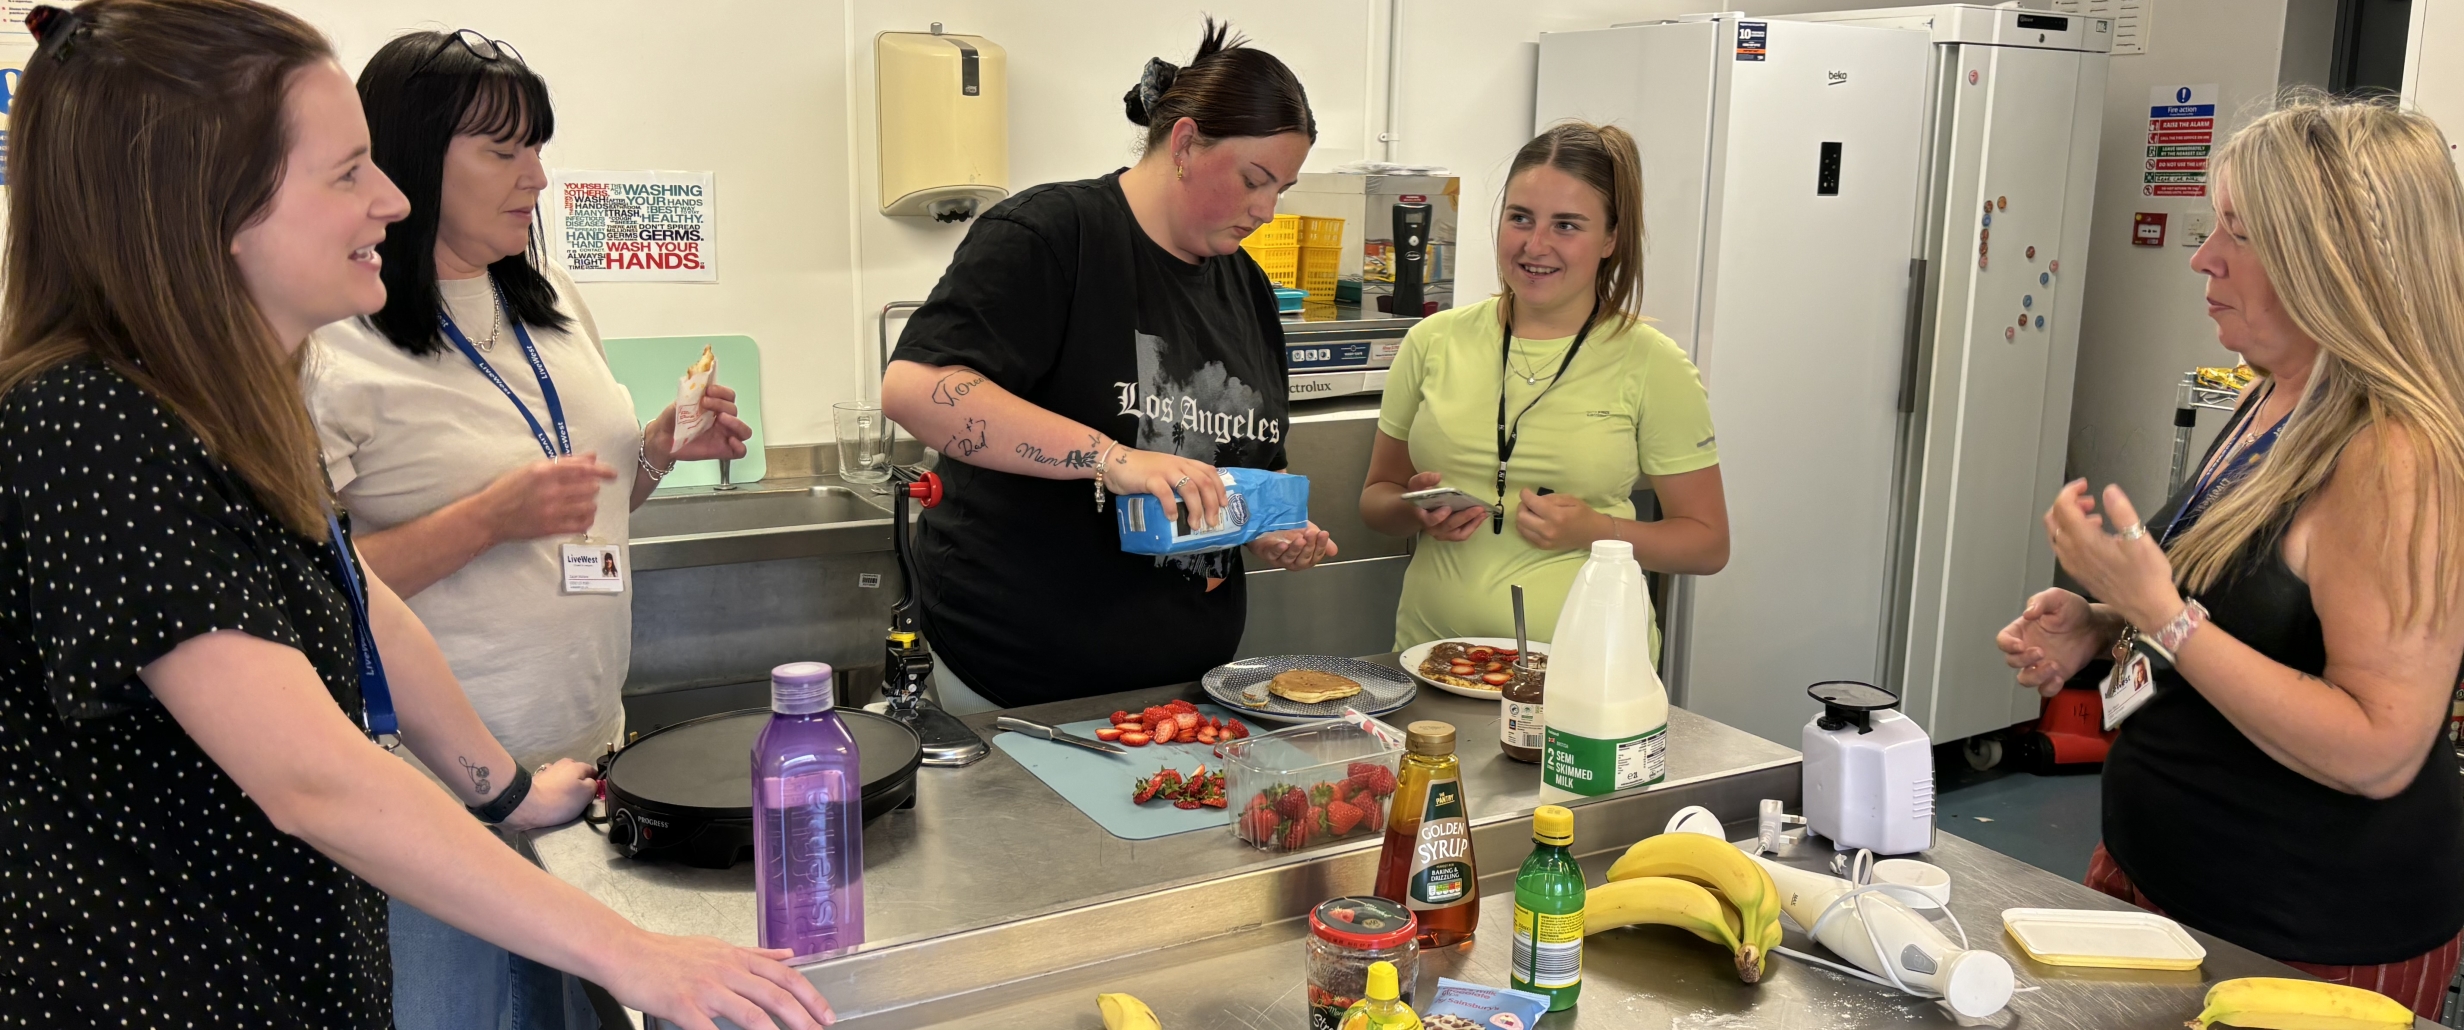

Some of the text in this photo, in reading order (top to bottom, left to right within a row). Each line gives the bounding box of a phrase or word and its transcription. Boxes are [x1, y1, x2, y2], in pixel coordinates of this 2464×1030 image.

[1739, 28, 1752, 40] 10
[1828, 70, 1847, 80] beko
[622, 184, 702, 196] WASHING
[626, 196, 666, 205] YOUR
[650, 206, 679, 214] BEST
[641, 214, 704, 223] HEALTHY.
[566, 231, 606, 240] HAND
[639, 230, 704, 241] GERMS.
[606, 242, 698, 252] WASH YOUR
[606, 253, 705, 270] HANDS.
[526, 345, 548, 380] LiveWest
[479, 362, 511, 395] LiveWest
[1289, 381, 1332, 393] ctrolux
[1113, 381, 1280, 444] Los Angeles
[557, 422, 572, 456] veWest
[958, 431, 989, 456] Dad
[538, 432, 555, 459] LiveW
[1016, 443, 1063, 467] Mum
[567, 554, 598, 564] LiveWest
[1548, 748, 1555, 765] 2
[1556, 751, 1574, 765] SEMI
[1556, 762, 1593, 780] SKIMMED
[1556, 774, 1574, 789] MILK
[1436, 794, 1454, 804] PANTRY
[638, 816, 669, 828] PROGRESS
[1421, 822, 1466, 841] GOLDEN
[1418, 838, 1468, 865] SYRUP
[1431, 872, 1459, 881] DRIZZLING
[1432, 868, 1453, 876] BAKING
